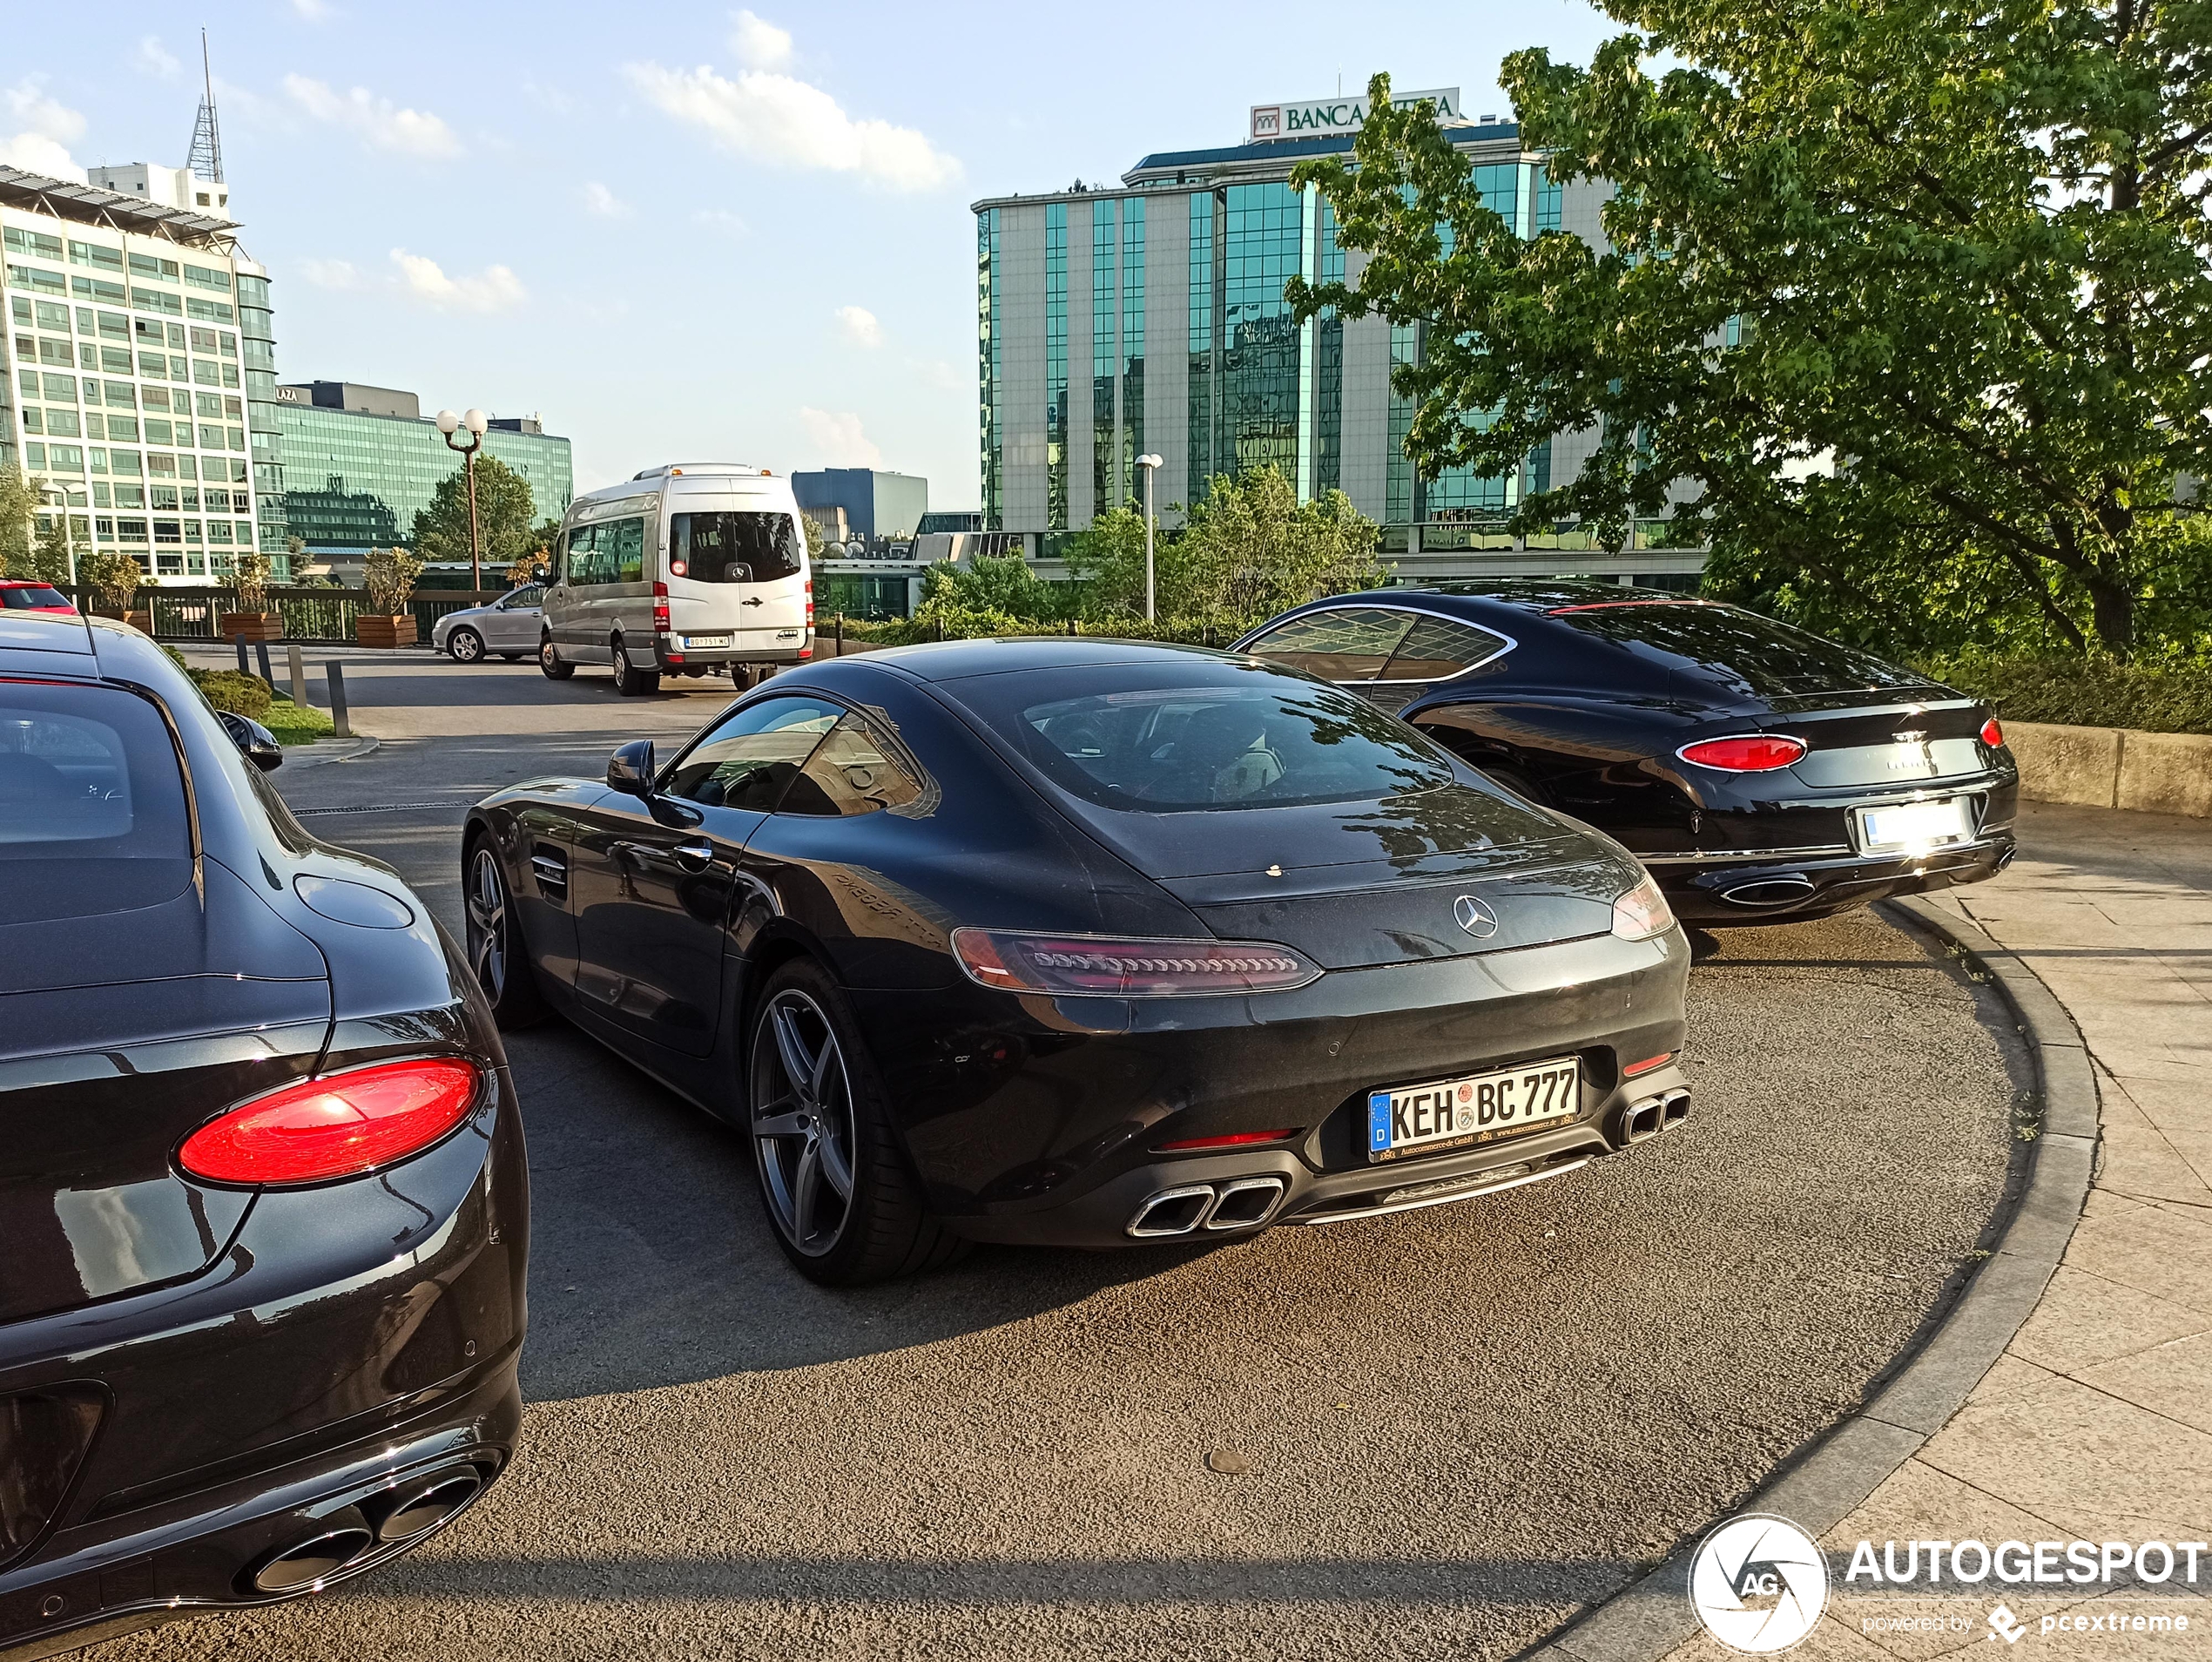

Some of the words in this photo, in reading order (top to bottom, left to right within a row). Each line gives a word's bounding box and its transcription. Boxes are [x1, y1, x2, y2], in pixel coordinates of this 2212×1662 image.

[1286, 104, 1365, 131] BANCA
[1392, 1090, 1453, 1141] KEH
[1478, 1079, 1514, 1125] BC
[1524, 1068, 1575, 1116] 777
[1376, 1129, 1385, 1142] D
[1496, 1118, 1557, 1137] www.autocommerce.de
[1453, 1135, 1474, 1145] GmbH
